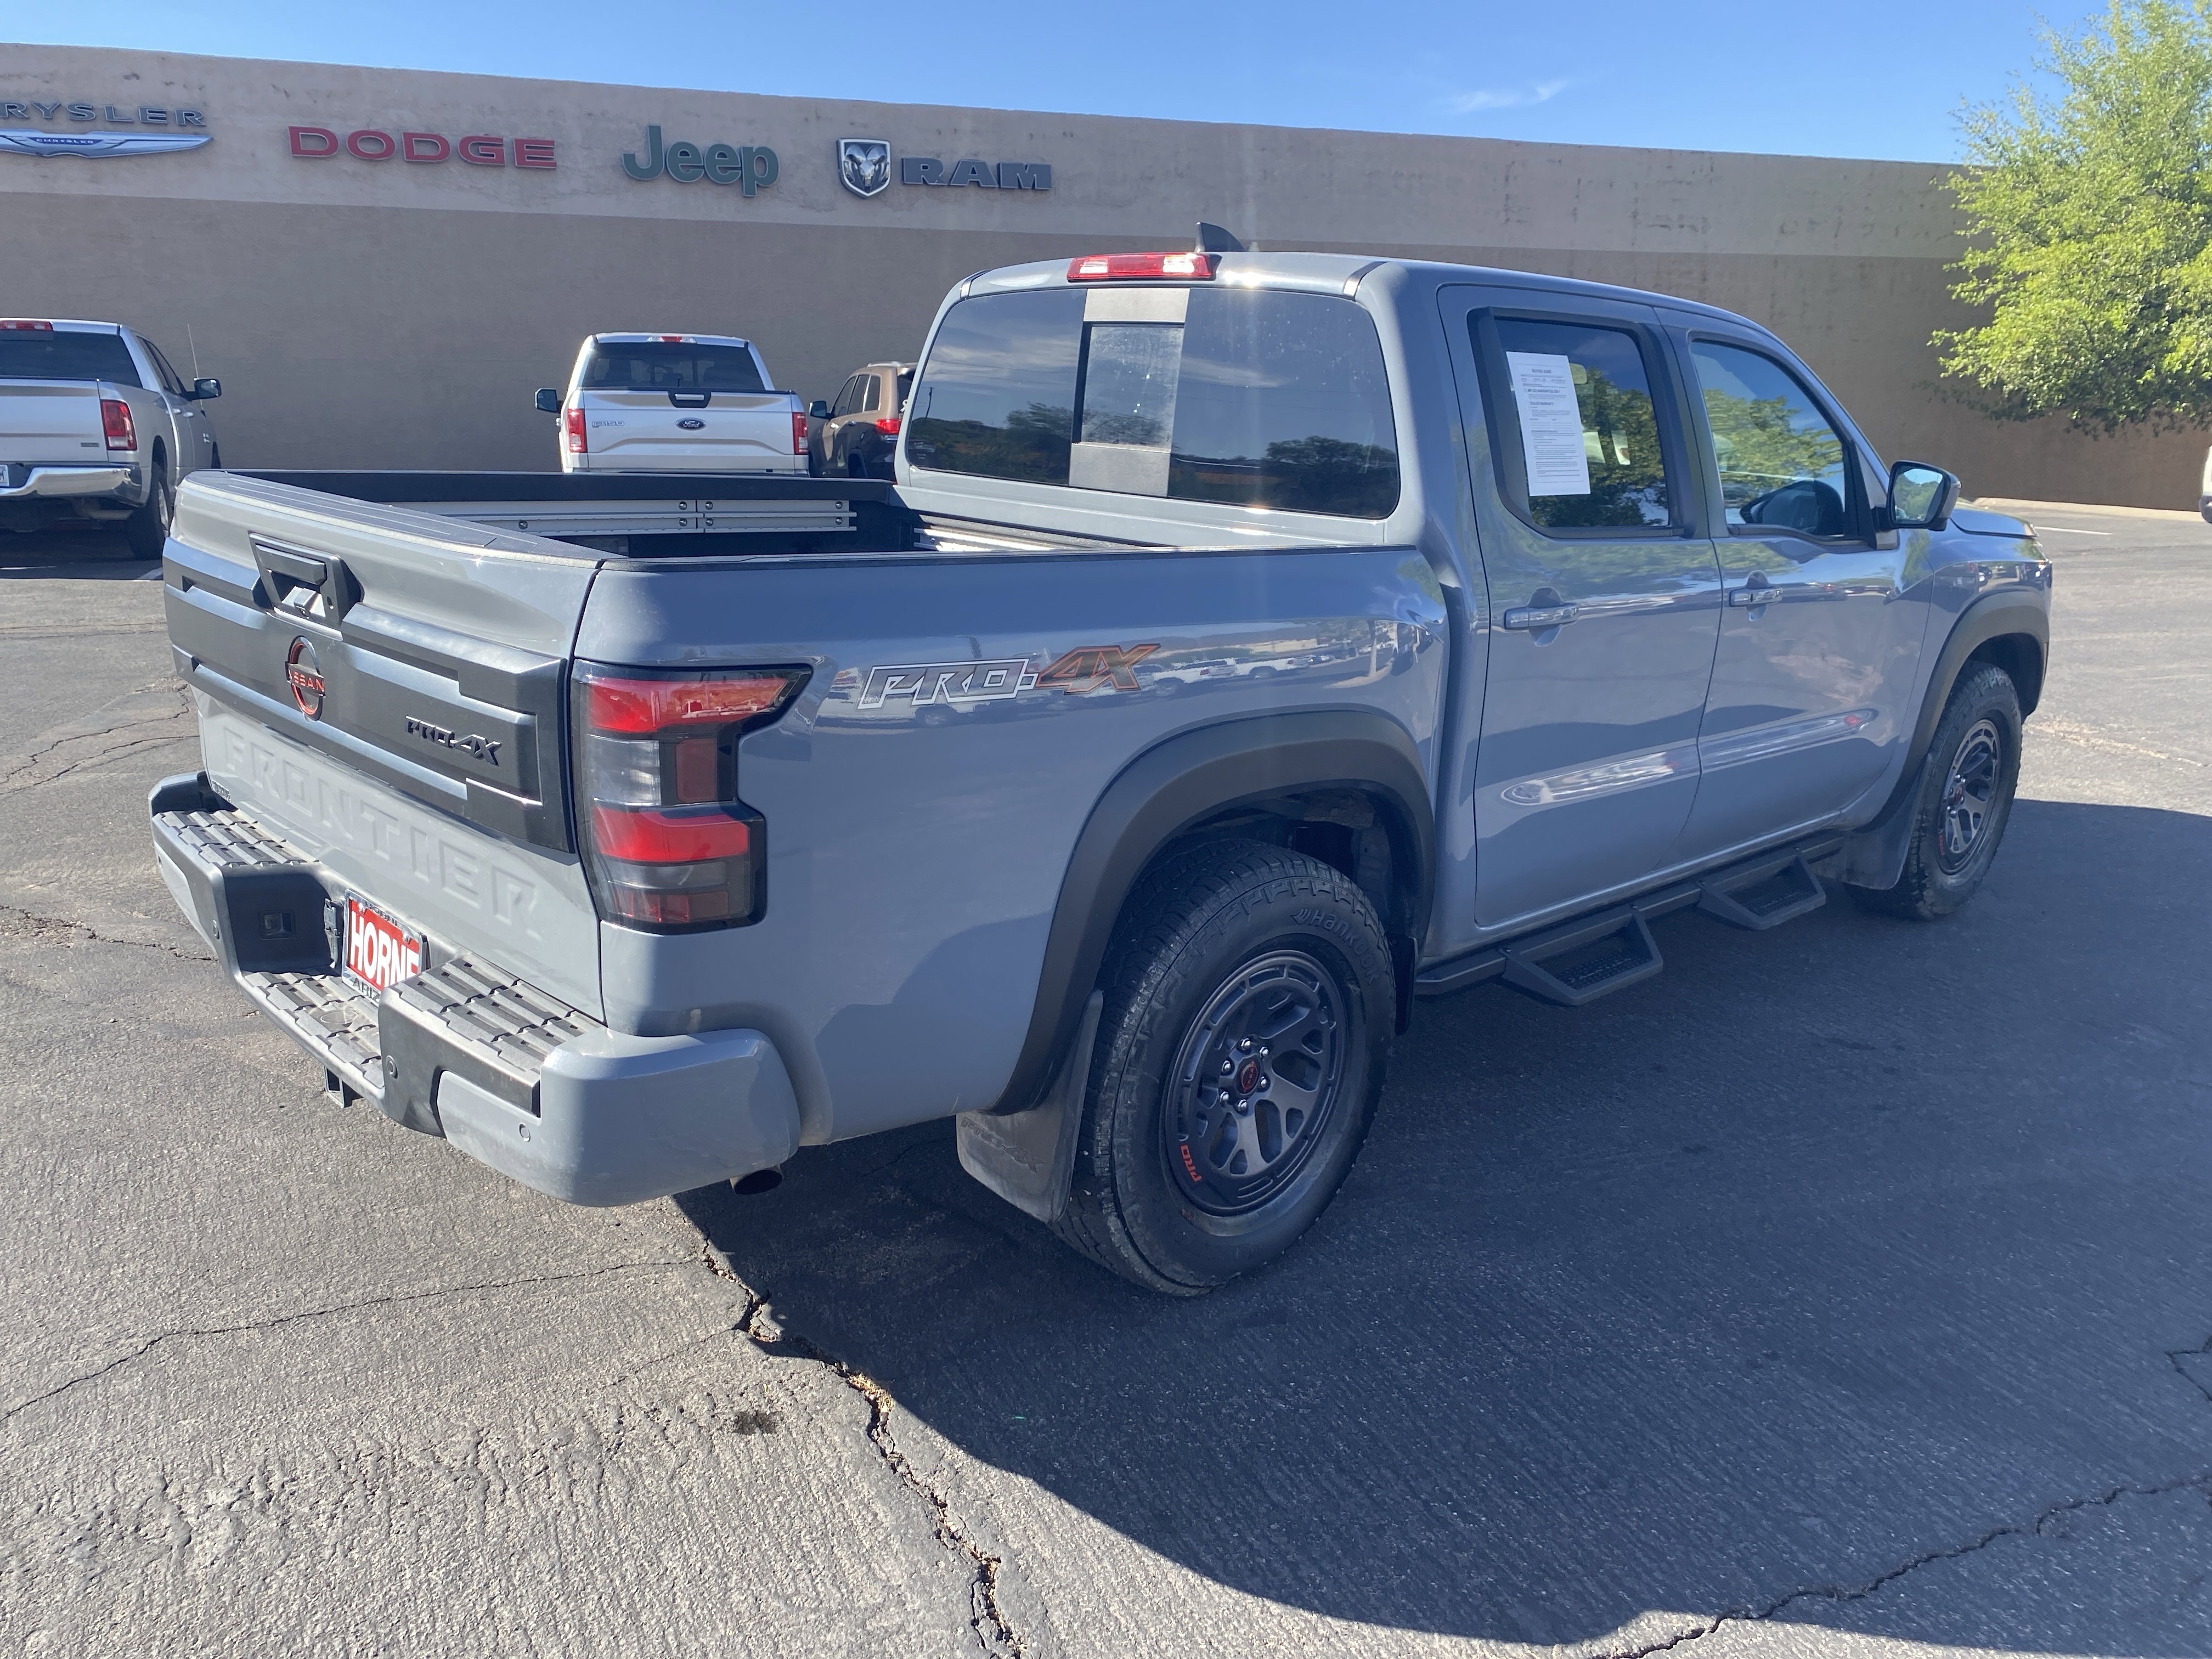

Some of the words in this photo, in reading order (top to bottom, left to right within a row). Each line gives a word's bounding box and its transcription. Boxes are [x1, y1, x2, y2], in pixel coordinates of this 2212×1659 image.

[288, 126, 557, 169] DODGE
[622, 125, 780, 198] Jeep
[902, 157, 1052, 190] RAM
[223, 725, 543, 941] FRONTIER
[350, 911, 419, 988] HORNE
[1308, 908, 1380, 986] Hankook
[1180, 1144, 1202, 1182] PRO
